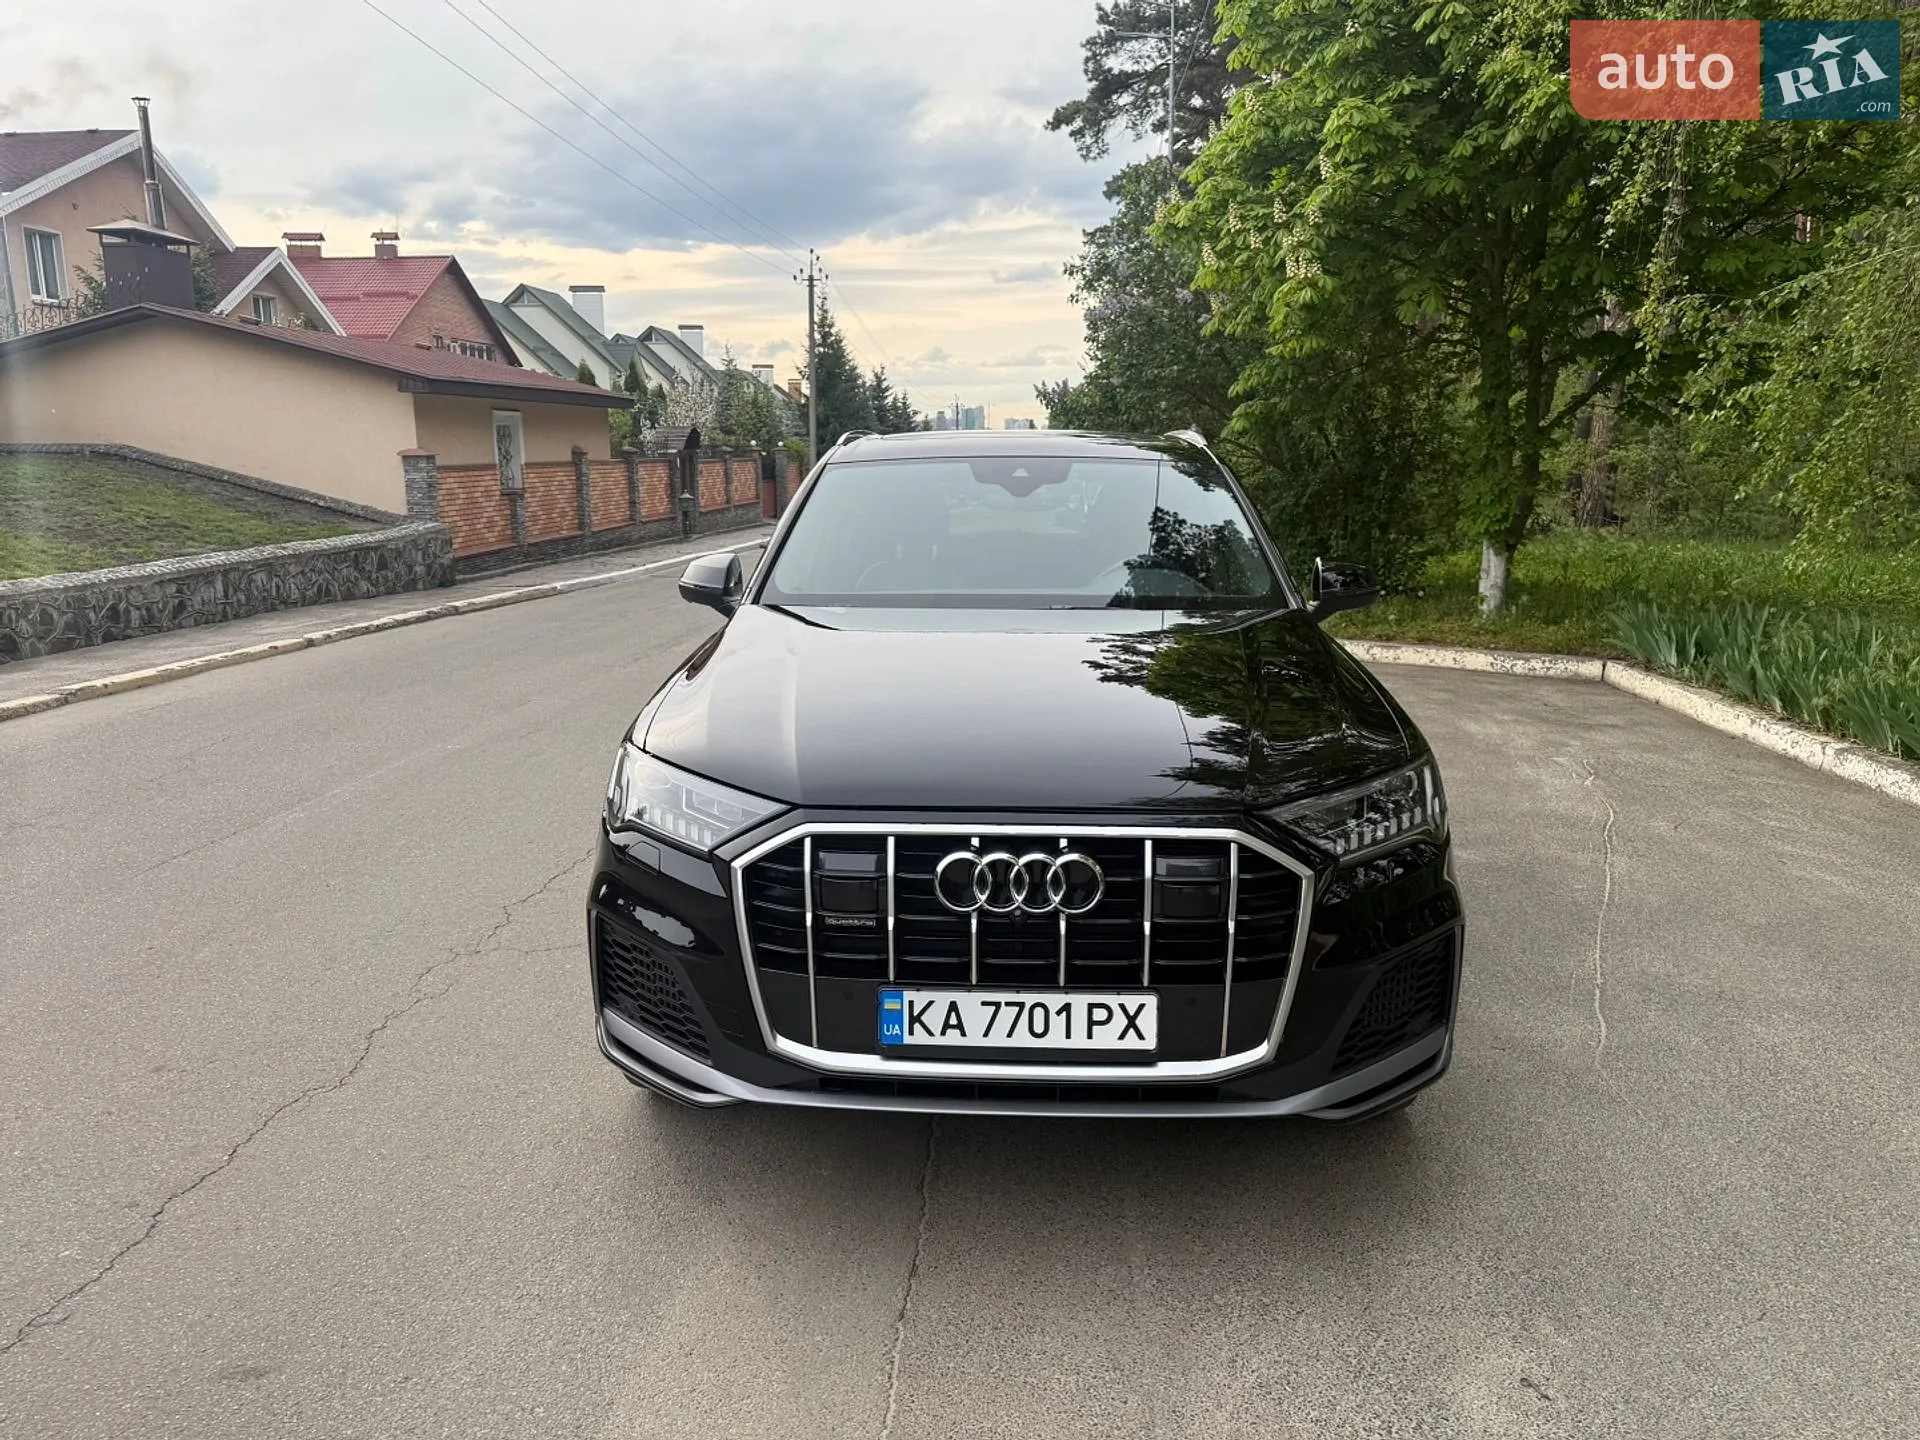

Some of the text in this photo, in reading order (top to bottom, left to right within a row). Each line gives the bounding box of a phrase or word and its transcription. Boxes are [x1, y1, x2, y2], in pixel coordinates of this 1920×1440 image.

[884, 1024, 901, 1036] UA
[907, 1000, 1147, 1041] KA 7701 PX
